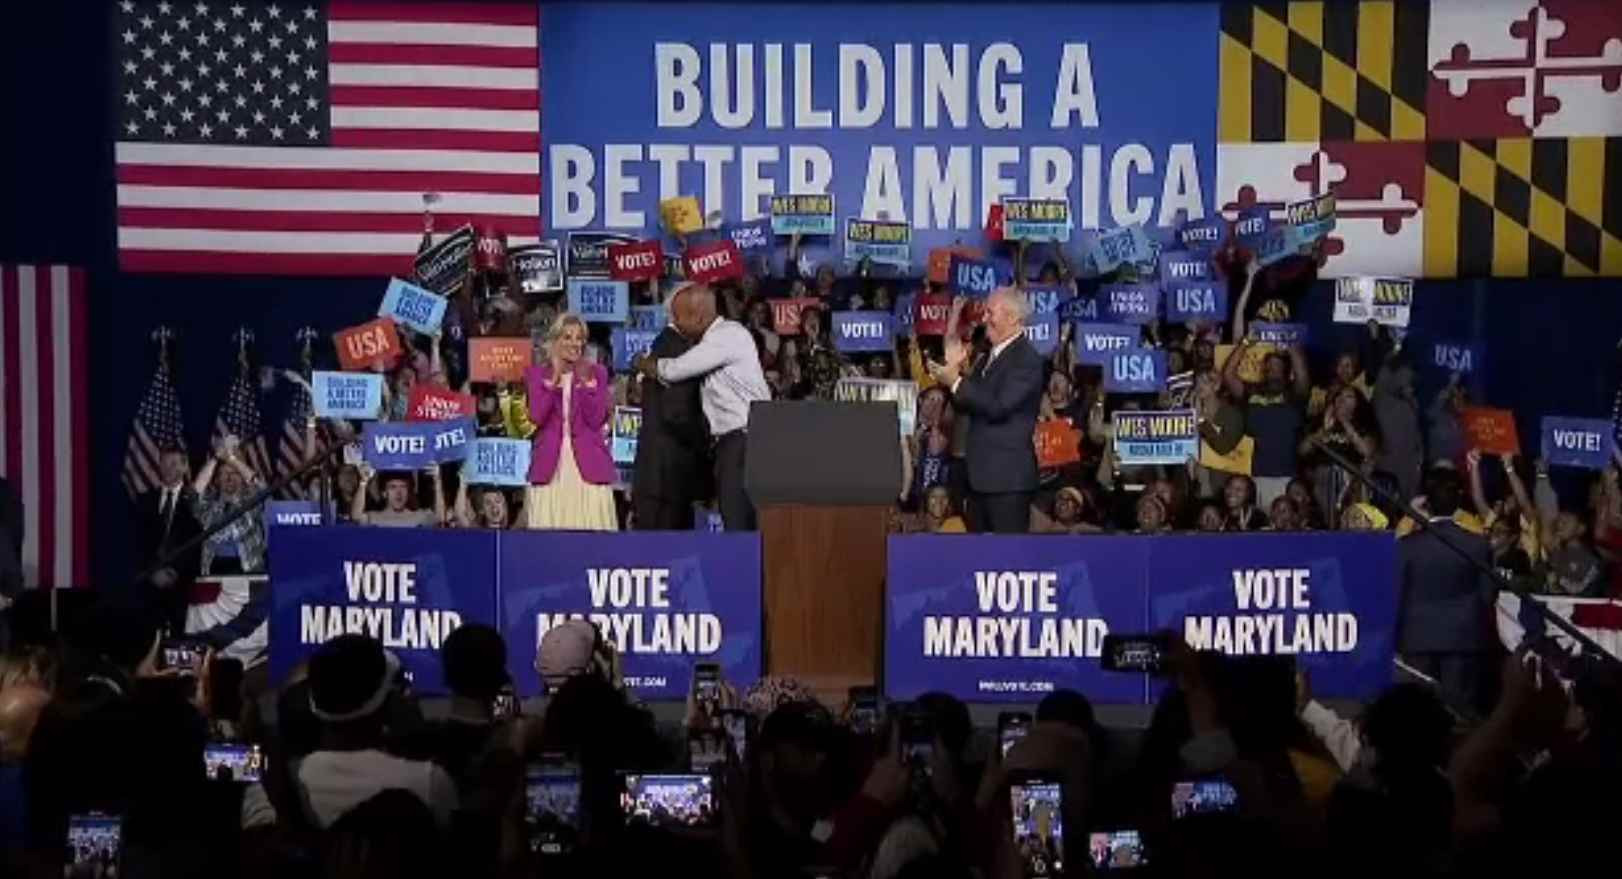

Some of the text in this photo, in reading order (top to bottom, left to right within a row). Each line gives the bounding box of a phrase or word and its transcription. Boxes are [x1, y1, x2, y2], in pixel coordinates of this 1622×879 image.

[655, 42, 1099, 128] BUILDING A
[549, 144, 1205, 230] BETTER AMERICA
[1182, 228, 1218, 244] VOTE!
[615, 251, 656, 271] VOTE!
[689, 250, 732, 274] VOTE!
[957, 262, 997, 292] USA
[920, 304, 948, 321] VOT
[1176, 288, 1215, 312] USA
[775, 304, 802, 326] US
[345, 325, 390, 360] USA
[842, 321, 884, 339] VOTE!
[1113, 354, 1155, 382] USA
[1434, 343, 1472, 371] USA
[374, 434, 426, 455] VOTE!
[434, 428, 467, 449] TE!
[1553, 428, 1601, 451] VOTE!
[343, 560, 416, 604] VOTE
[587, 568, 670, 608] VOTE
[975, 571, 1057, 612] VOTE
[1232, 568, 1310, 609] VOTE
[923, 616, 1109, 658] MARYLAND
[1184, 613, 1358, 655] MARYLAND
